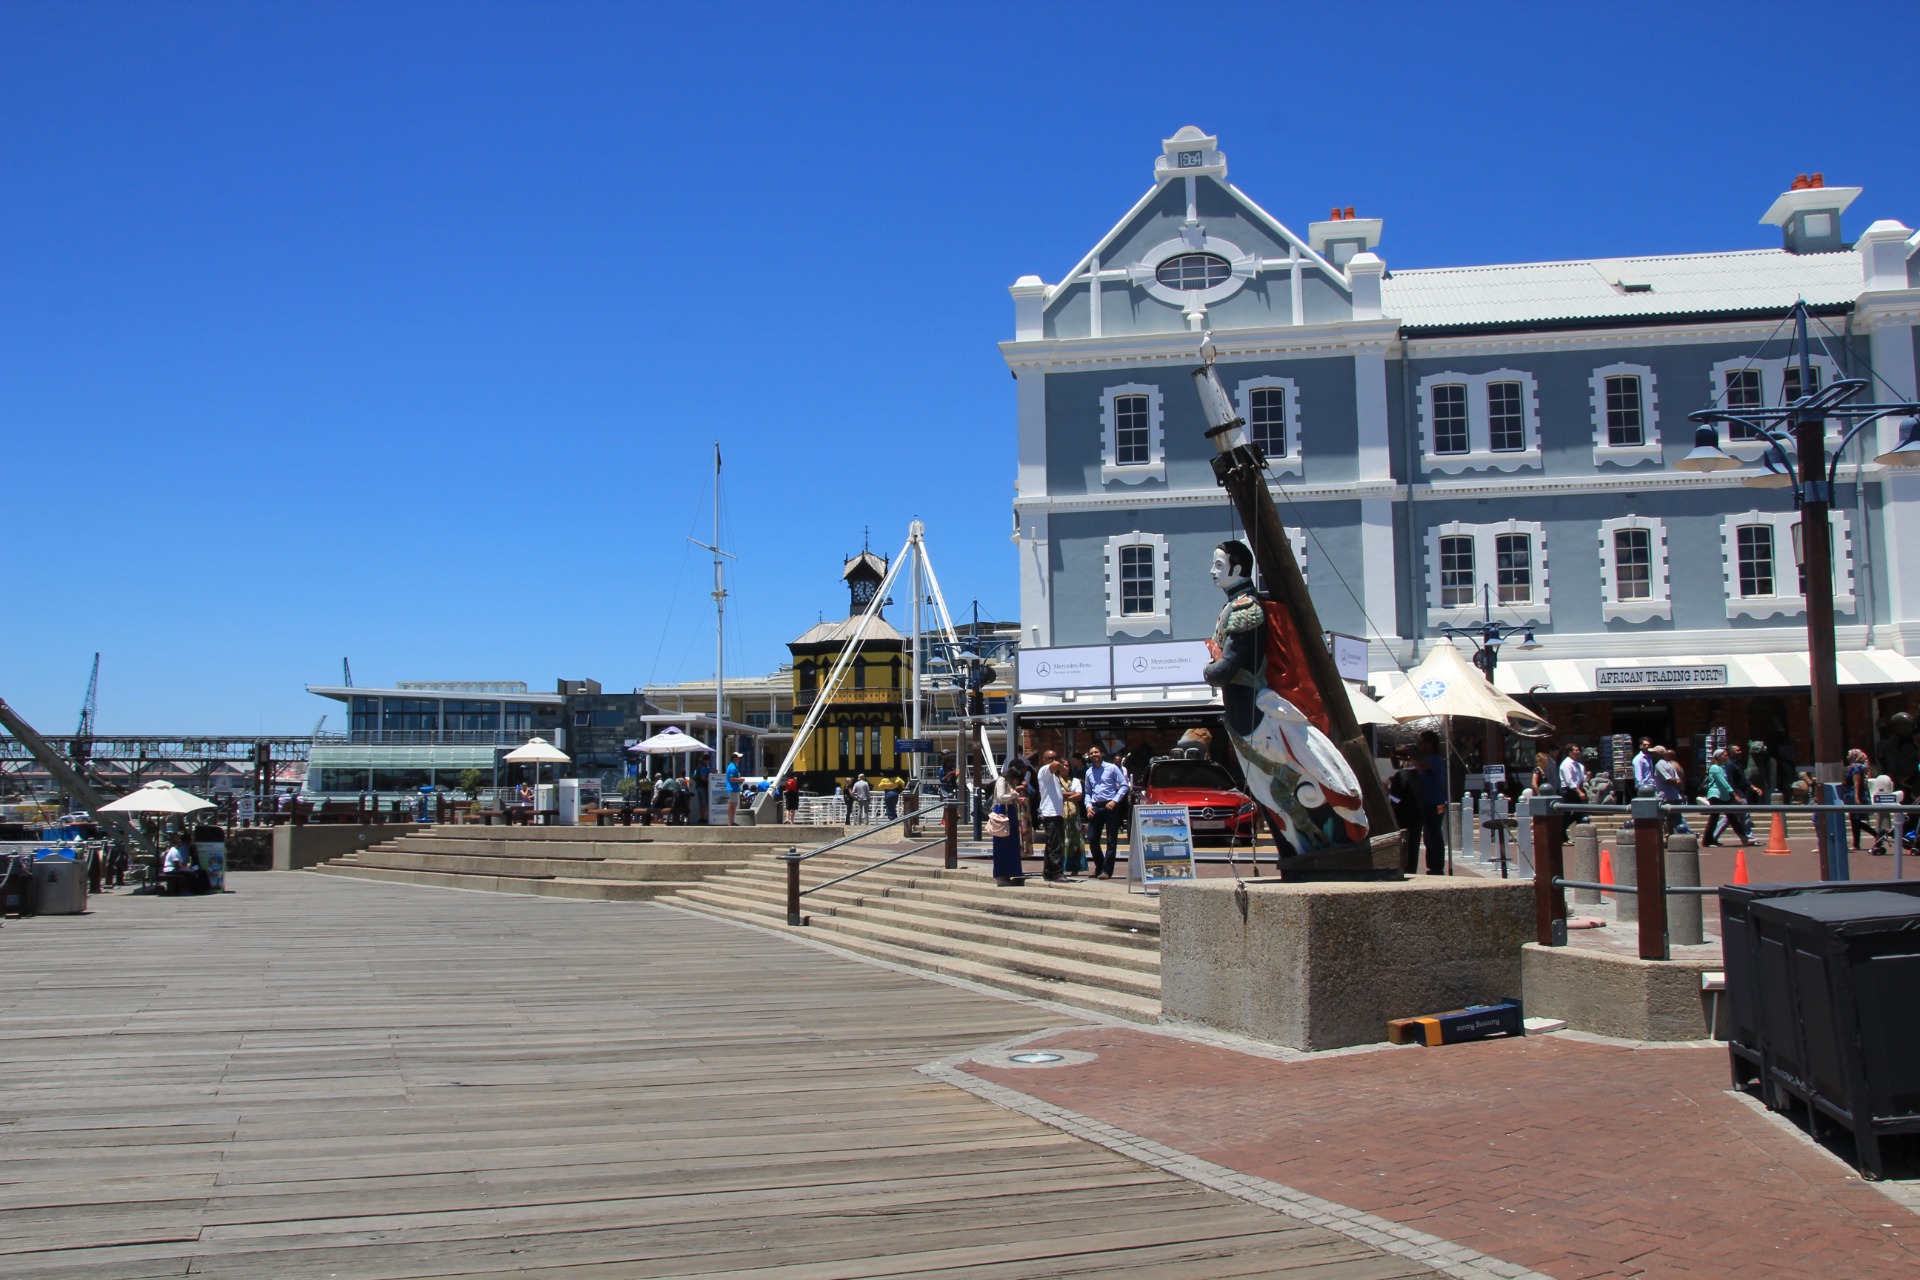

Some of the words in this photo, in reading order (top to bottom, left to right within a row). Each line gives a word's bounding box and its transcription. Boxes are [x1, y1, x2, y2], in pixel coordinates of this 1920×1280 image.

[1053, 662, 1092, 670] Mercedes-Benz
[1600, 672, 1643, 684] AFRICAN
[1646, 670, 1691, 683] TRADING
[1456, 1023, 1475, 1031] Route
[1476, 1019, 1500, 1028] Running
